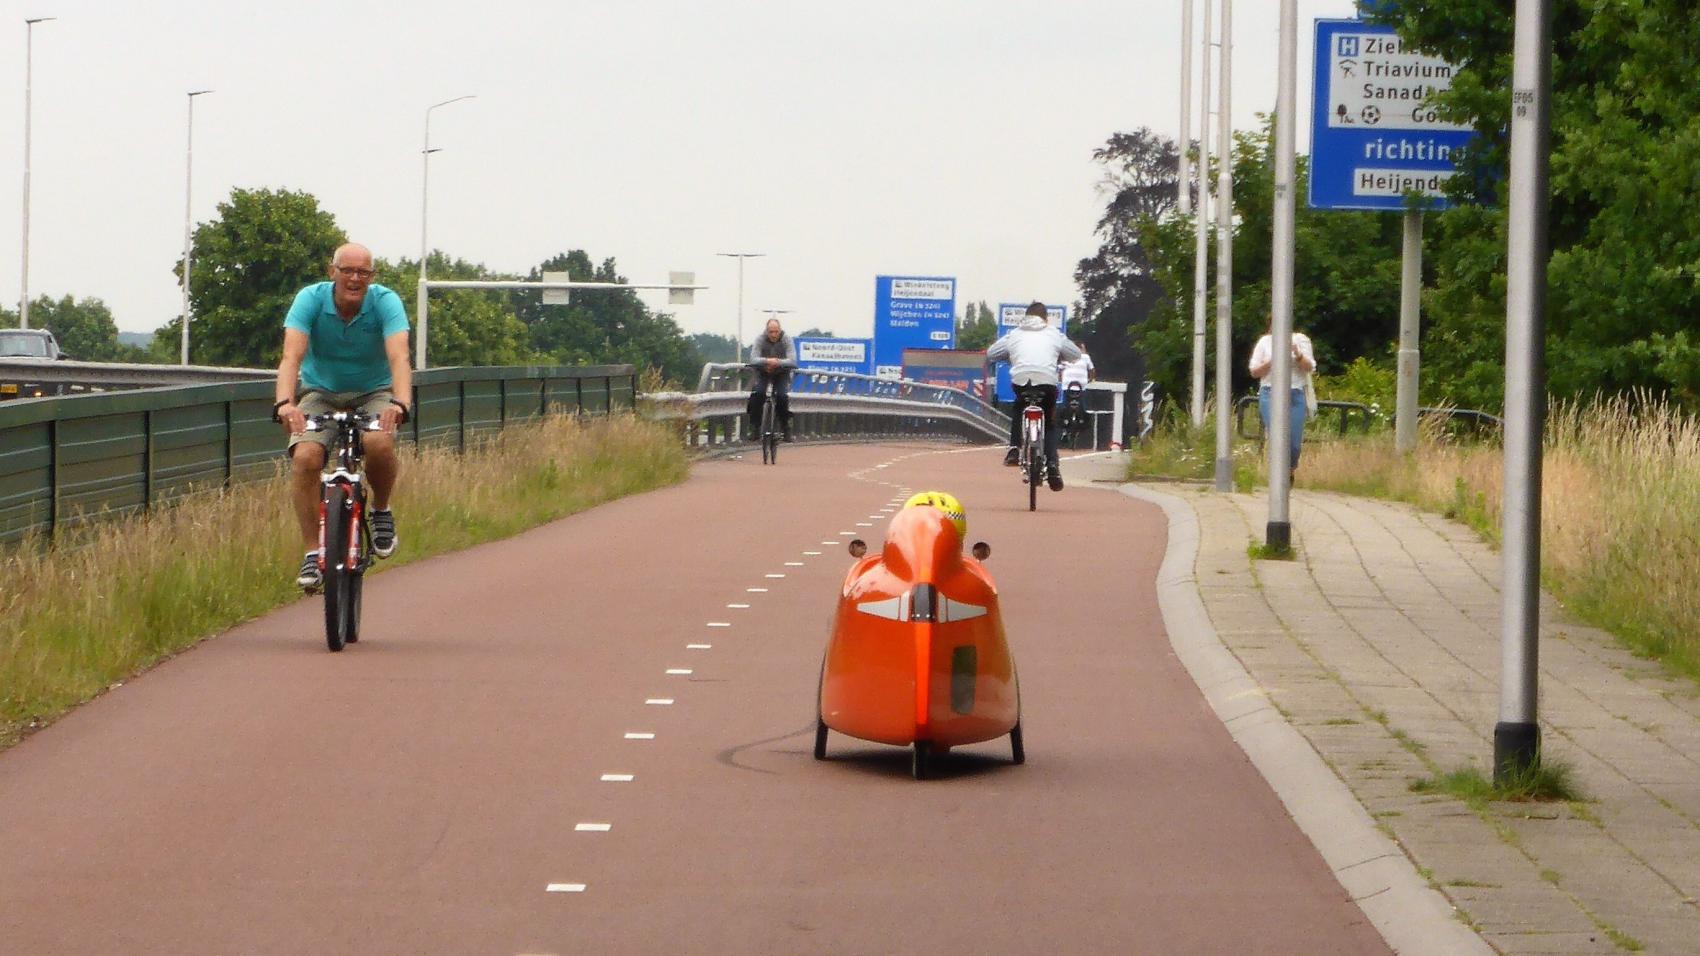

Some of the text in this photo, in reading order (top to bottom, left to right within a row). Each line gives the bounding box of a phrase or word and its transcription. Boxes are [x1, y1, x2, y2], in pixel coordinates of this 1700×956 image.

[1363, 60, 1451, 78] Triavium
[1363, 83, 1431, 100] Sanad
[1411, 107, 1437, 123] Go
[1361, 173, 1439, 193] Heijend
